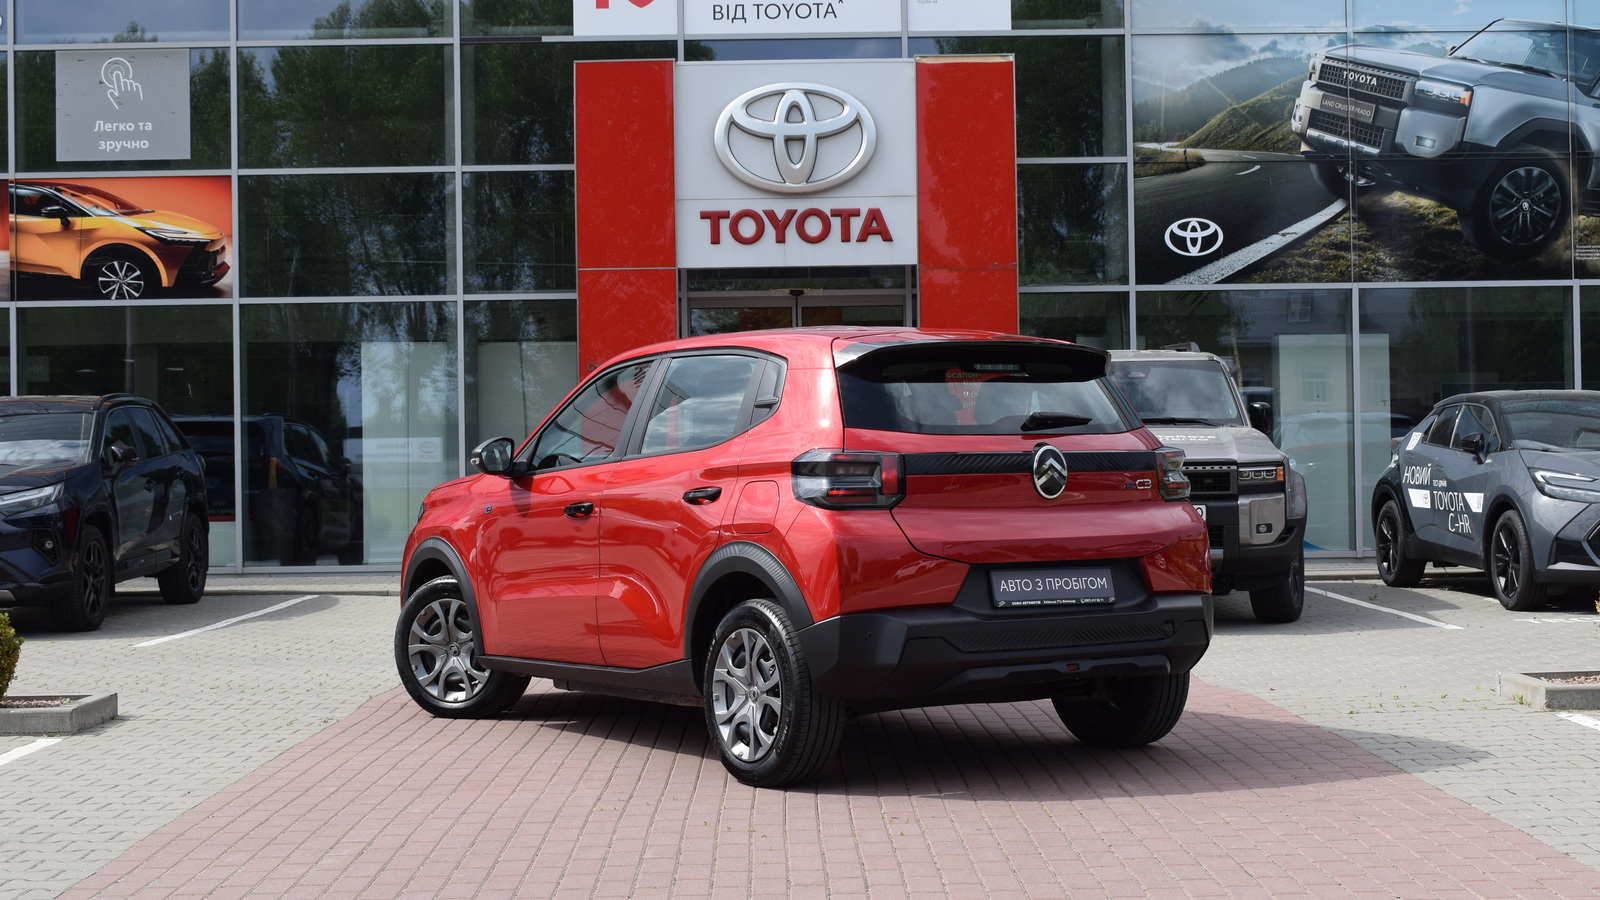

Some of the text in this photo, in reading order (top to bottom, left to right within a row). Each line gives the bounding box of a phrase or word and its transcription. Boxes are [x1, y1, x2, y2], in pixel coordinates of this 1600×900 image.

[712, 4, 747, 24] ВІД
[1343, 71, 1377, 86] TOYOTA
[94, 120, 153, 132] Легко та
[98, 139, 149, 152] зручно
[700, 207, 894, 245] TOYOTA
[1402, 463, 1432, 486] НОВИЙ
[1433, 490, 1466, 512] TOYOTA
[1448, 512, 1472, 534] C-HR
[1000, 579, 1032, 592] АВТО
[1045, 577, 1108, 590] ПРОБІГОМ
